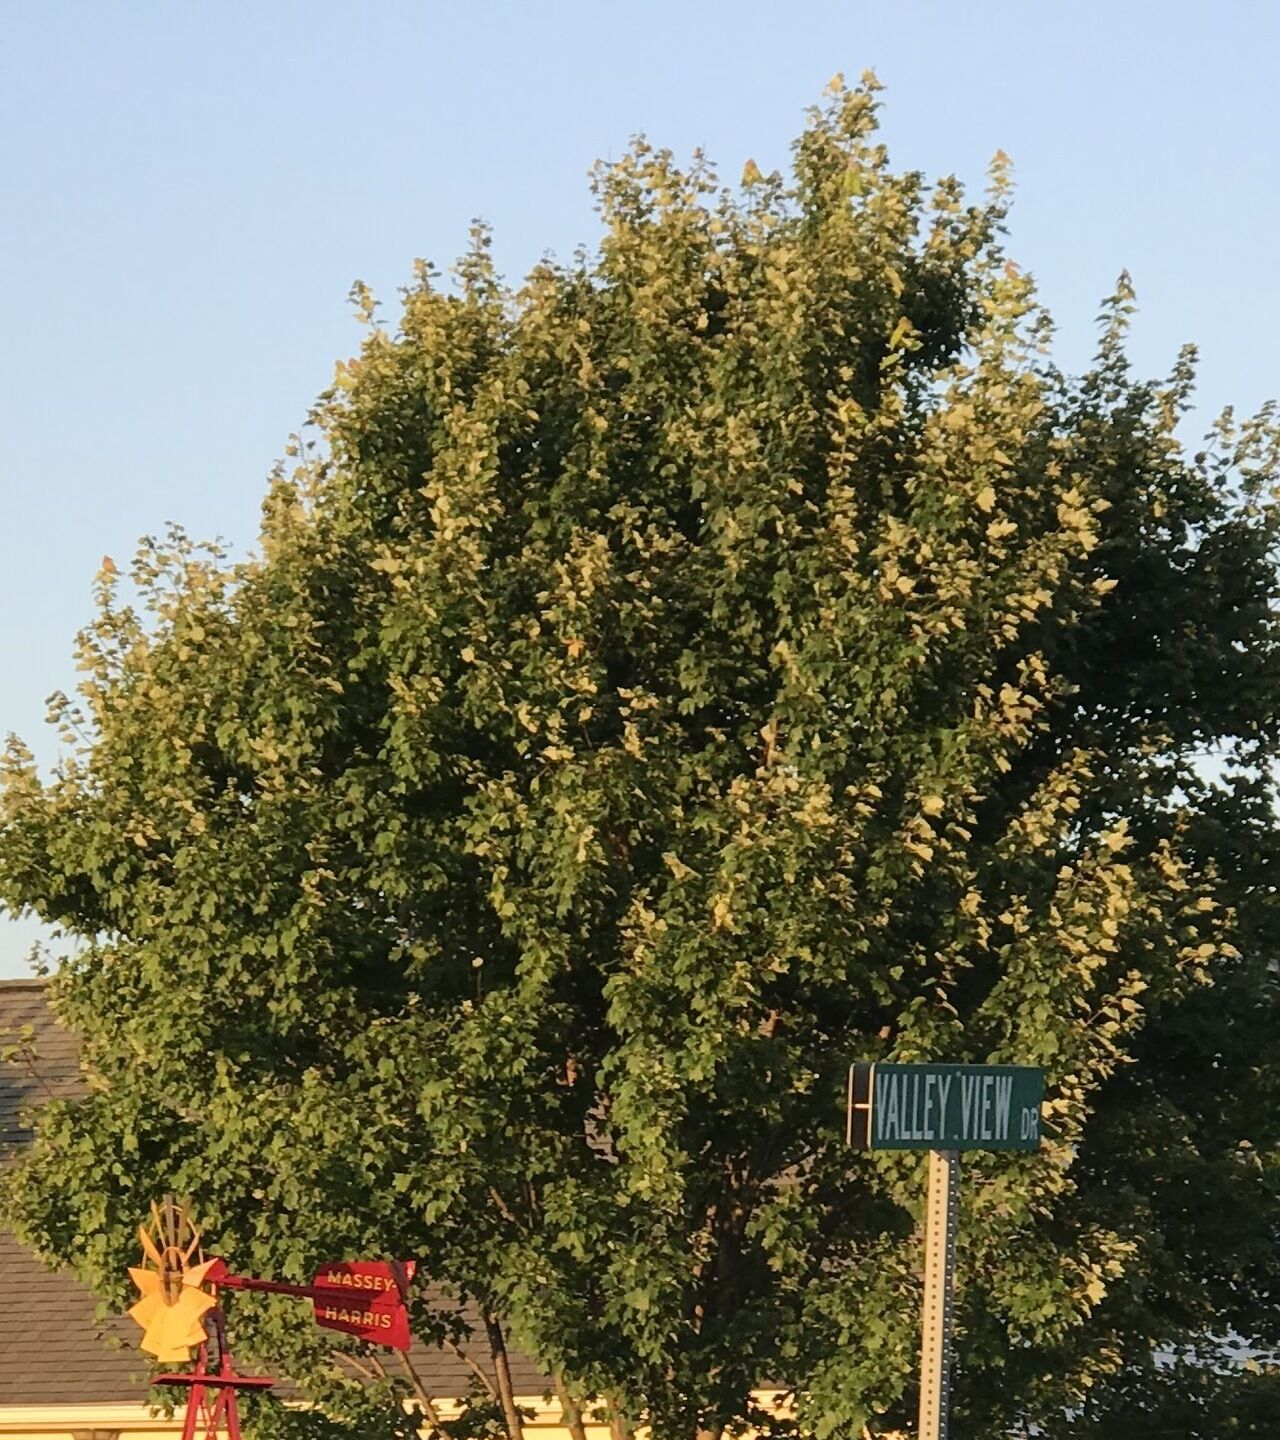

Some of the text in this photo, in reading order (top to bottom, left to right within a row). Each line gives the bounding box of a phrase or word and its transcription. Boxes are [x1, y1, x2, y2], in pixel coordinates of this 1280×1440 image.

[876, 1073, 1039, 1140] VALLEY VIEW DR
[325, 1306, 391, 1328] HARRIS
